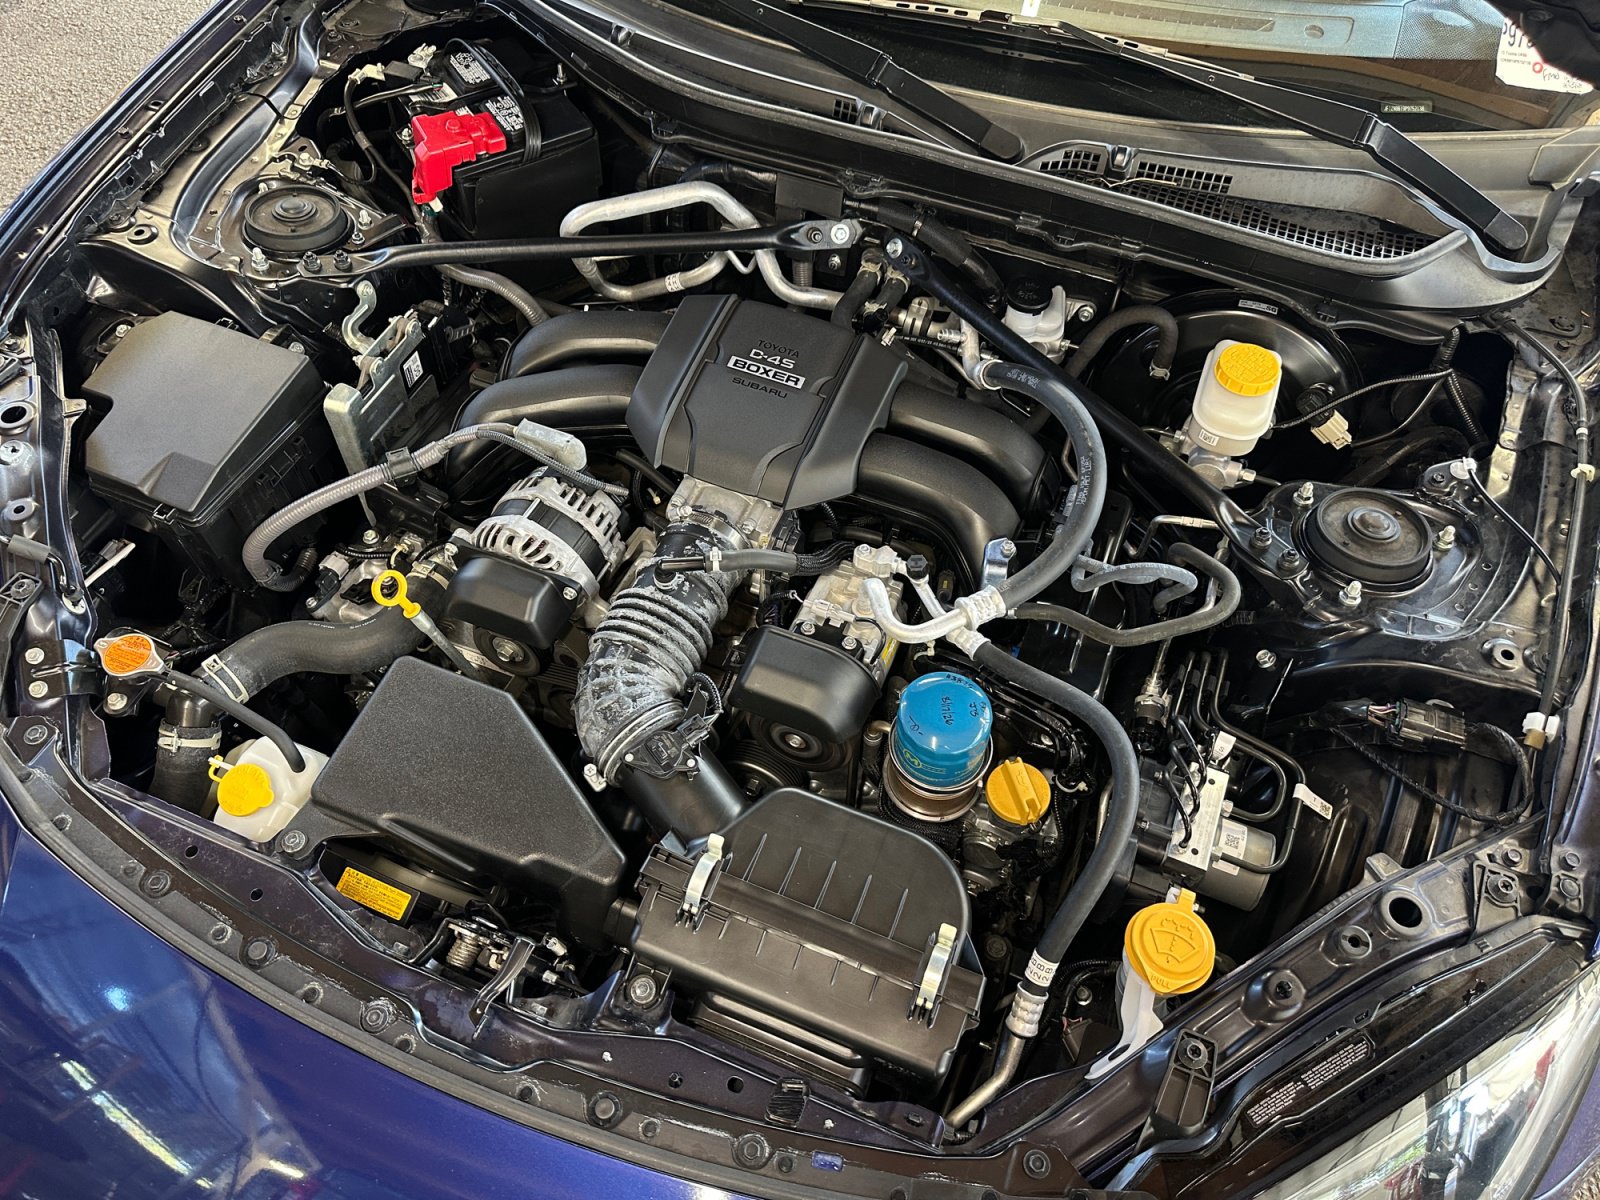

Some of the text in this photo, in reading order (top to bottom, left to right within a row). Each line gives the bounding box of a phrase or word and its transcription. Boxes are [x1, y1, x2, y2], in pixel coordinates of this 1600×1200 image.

[749, 348, 796, 369] D-4S
[758, 340, 800, 358] TOYOTA
[733, 358, 801, 386] BOXER
[732, 377, 788, 399] SUBARU
[1150, 974, 1172, 990] PULL
